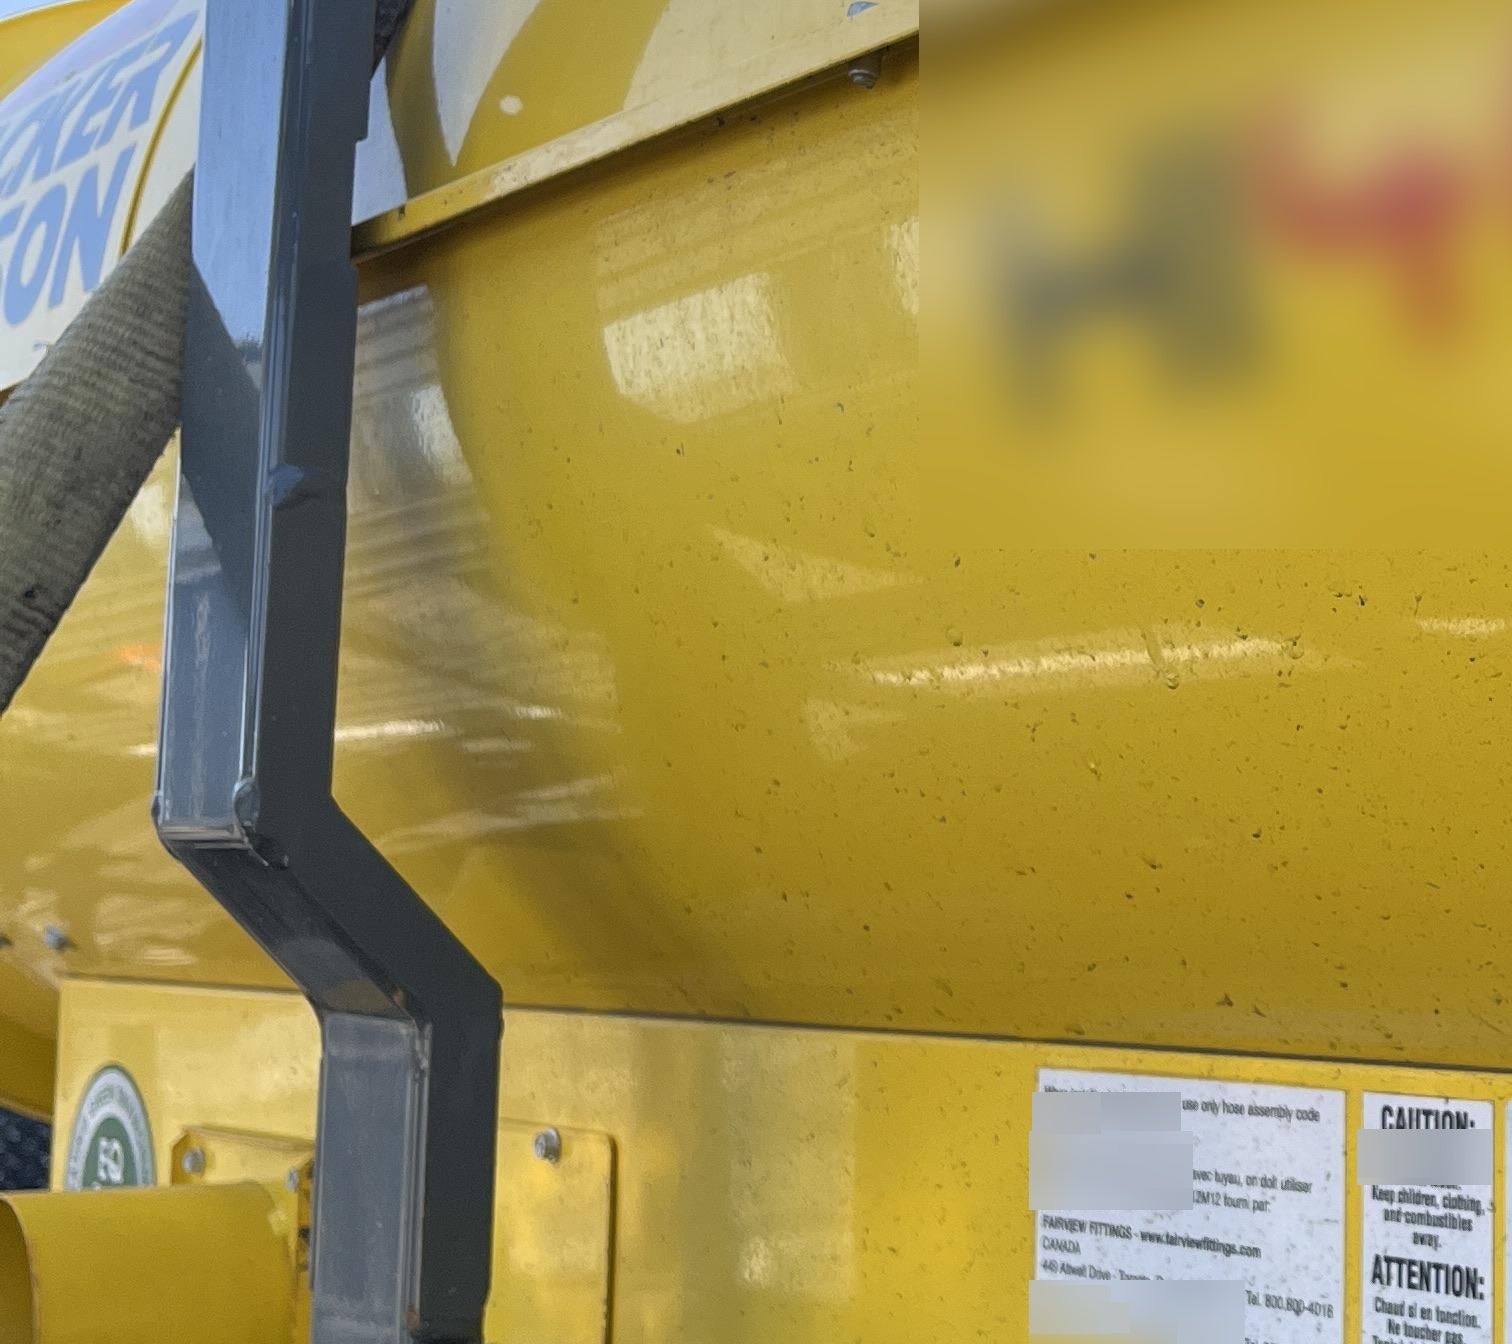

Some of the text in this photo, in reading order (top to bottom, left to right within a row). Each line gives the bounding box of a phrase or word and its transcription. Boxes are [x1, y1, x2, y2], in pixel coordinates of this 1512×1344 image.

[0, 143, 137, 326] ON
[1182, 1099, 1319, 1122] use only hose assembly code
[1245, 1175, 1258, 1186] on
[1372, 1184, 1395, 1204] Keep
[1384, 1206, 1473, 1232] and combustibles
[1041, 1235, 1081, 1254] CANADA
[1042, 1213, 1086, 1234] FAIRVIEW
[1089, 1220, 1132, 1240] FITTINGS
[1140, 1229, 1261, 1260] www.fairviewfittings.com
[1371, 1253, 1484, 1300] ATTENTION:
[1375, 1295, 1404, 1316] Chaud
[1420, 1306, 1432, 1320] en
[1387, 1318, 1400, 1335] Ne
[1403, 1320, 1441, 1342] toucher
